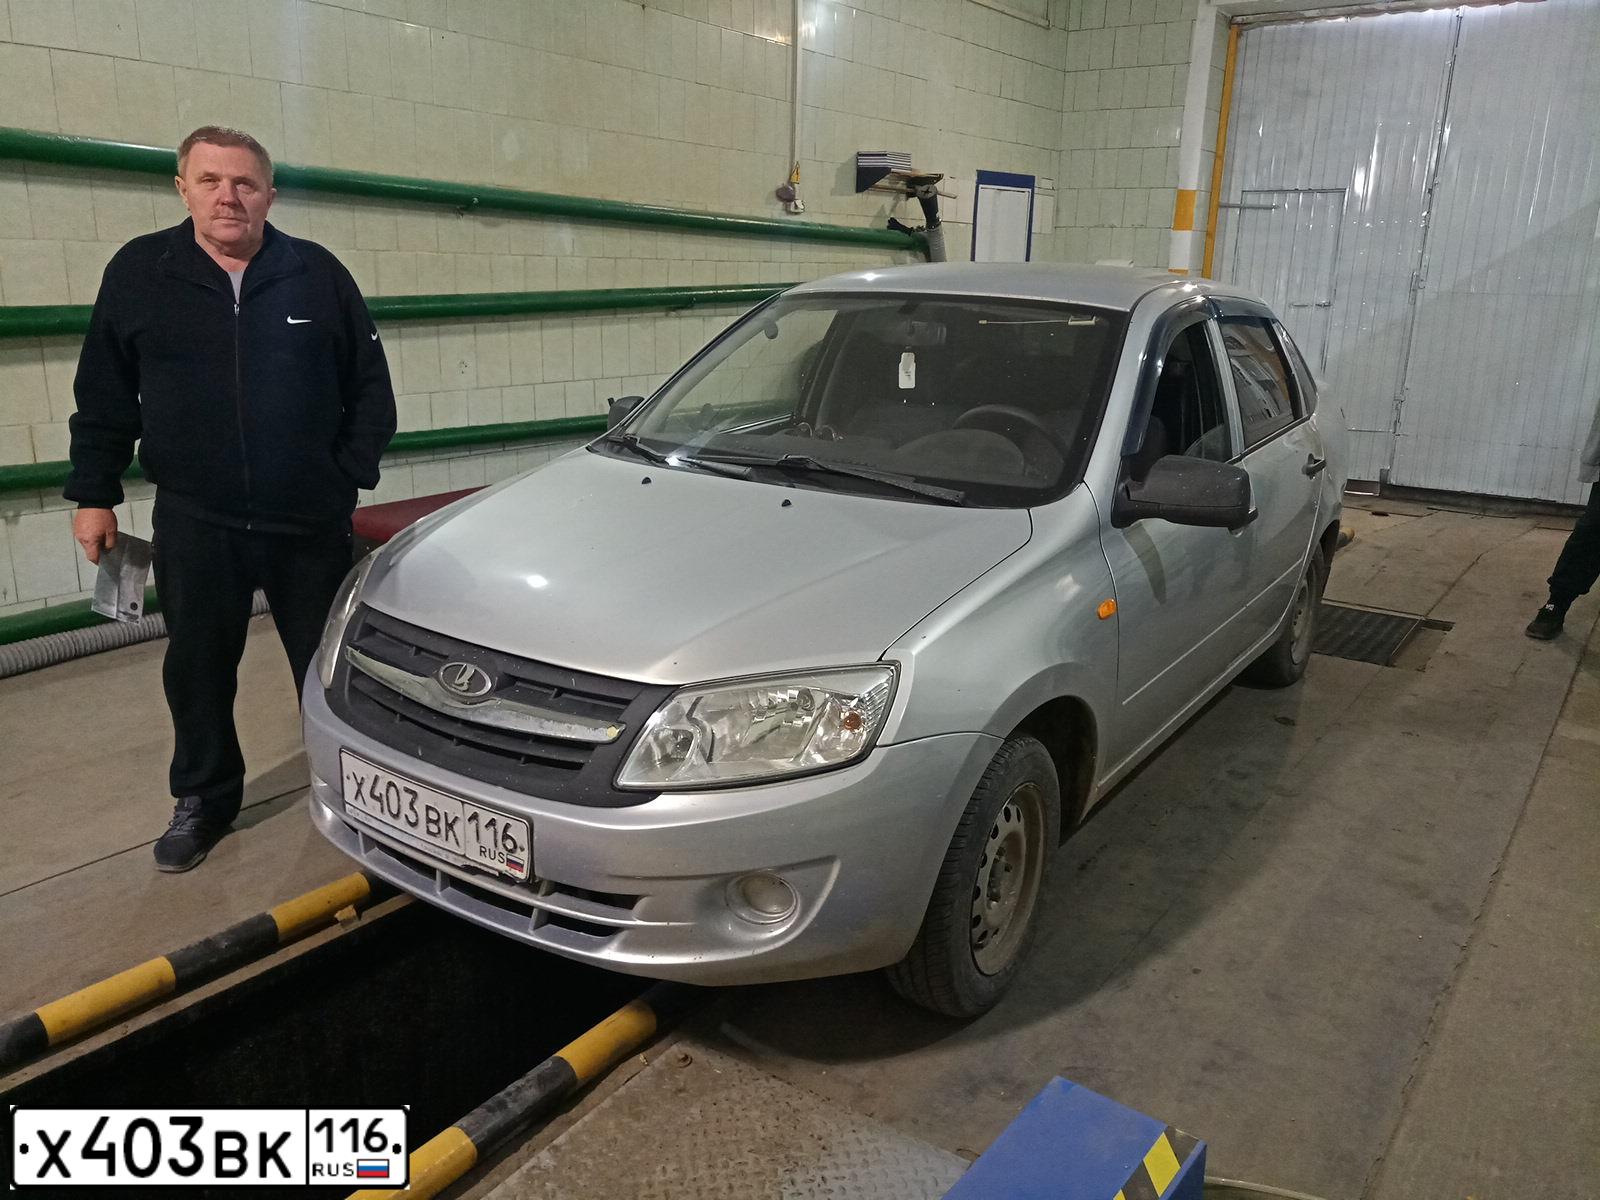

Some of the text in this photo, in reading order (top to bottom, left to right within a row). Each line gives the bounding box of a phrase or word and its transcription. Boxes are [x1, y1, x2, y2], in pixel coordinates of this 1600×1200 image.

[352, 771, 518, 854] Х403ВК 116
[479, 845, 505, 864] RUS
